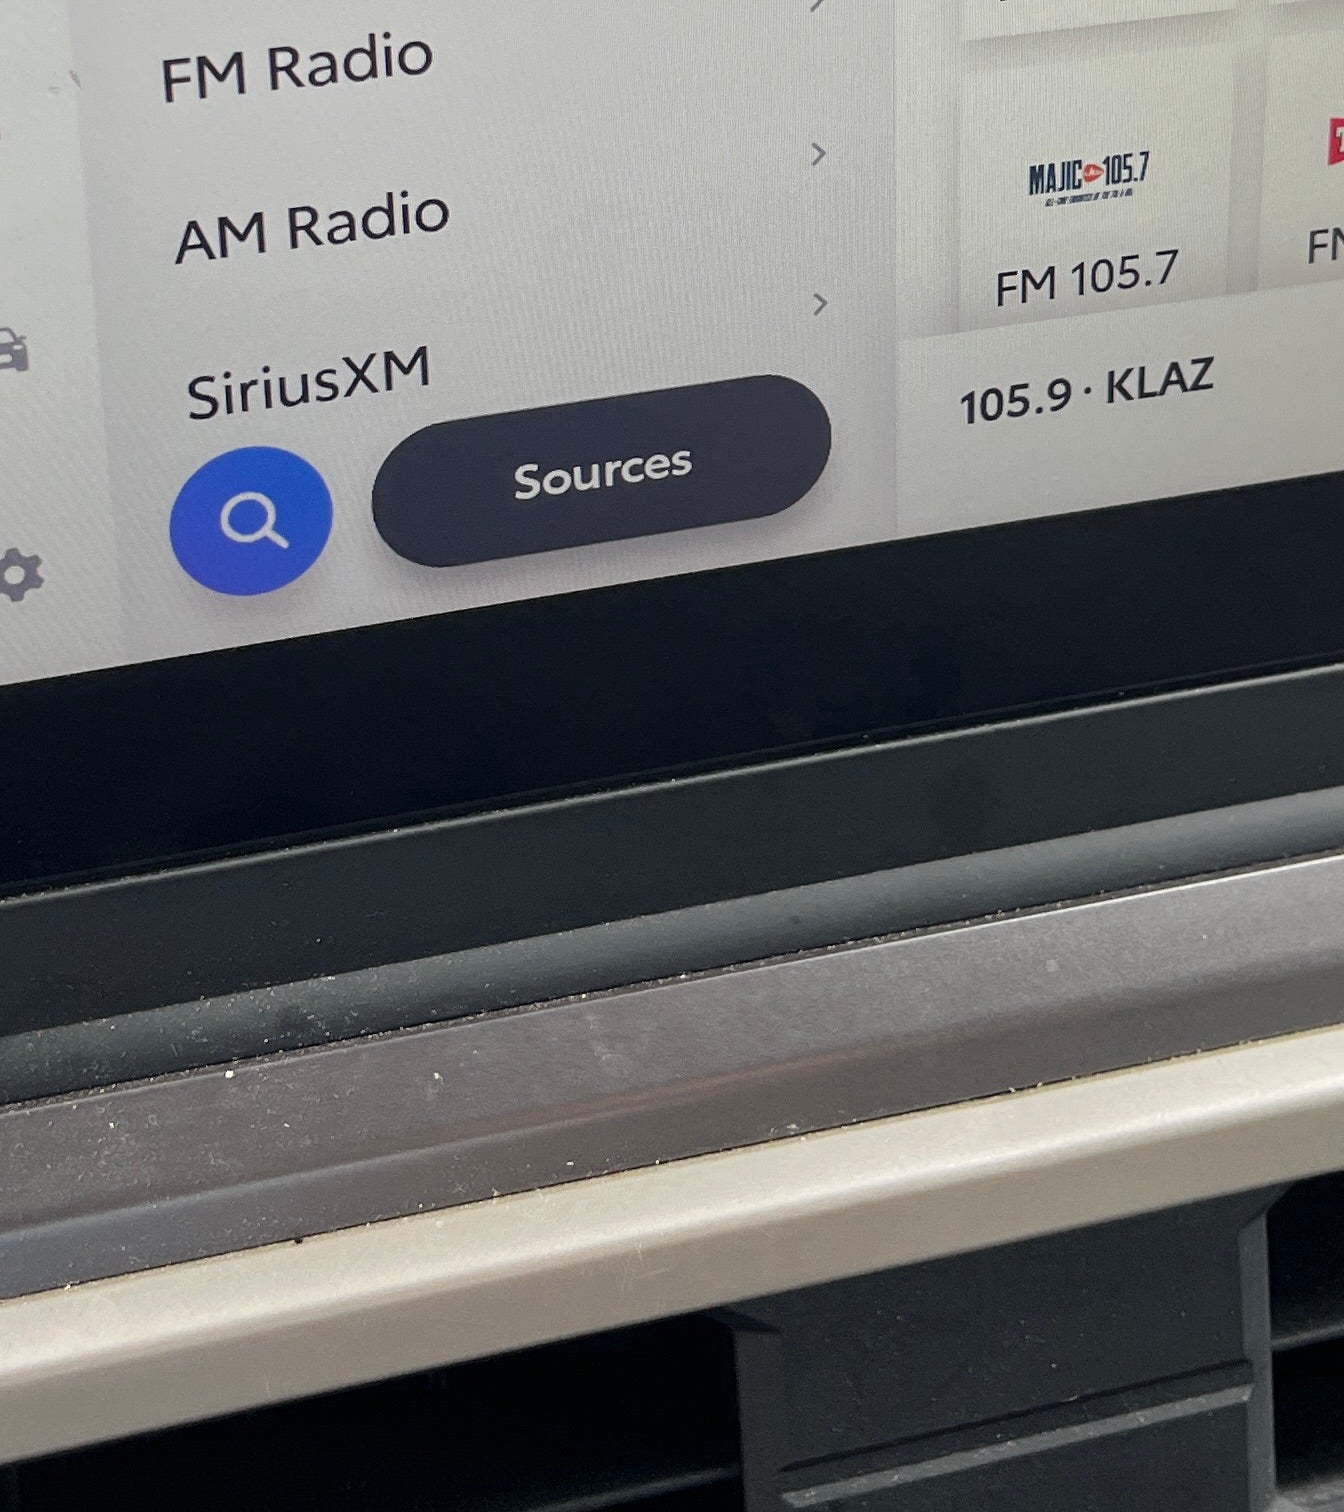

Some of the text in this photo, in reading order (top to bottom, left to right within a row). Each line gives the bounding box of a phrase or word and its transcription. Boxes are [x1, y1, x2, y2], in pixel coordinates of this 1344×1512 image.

[162, 31, 434, 103] FM Radio
[1029, 150, 1150, 196] MAJIC 105.7
[174, 190, 451, 265] AM Radio
[997, 249, 1180, 307] FM 105.7
[187, 344, 431, 421] SiriusXM
[960, 355, 1216, 424] 105.9 KLAZ
[513, 448, 694, 501] Sources
